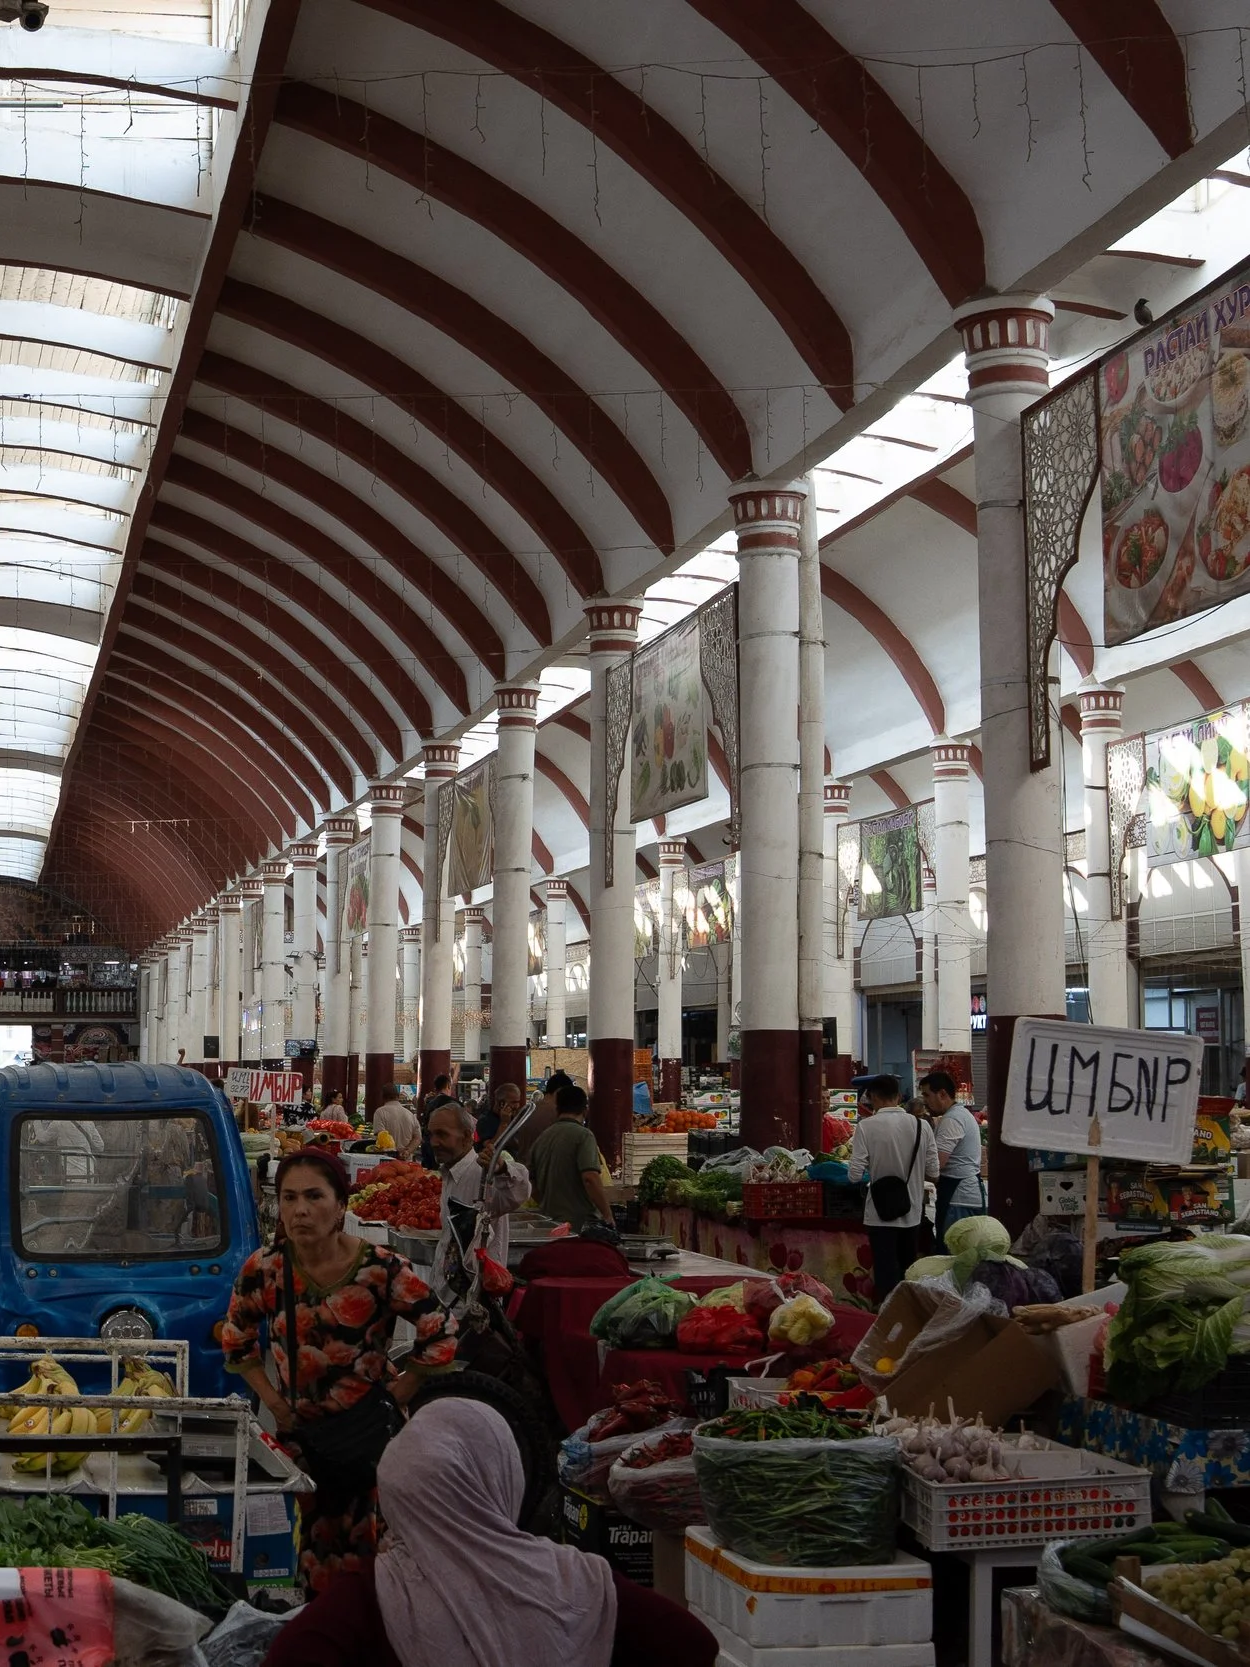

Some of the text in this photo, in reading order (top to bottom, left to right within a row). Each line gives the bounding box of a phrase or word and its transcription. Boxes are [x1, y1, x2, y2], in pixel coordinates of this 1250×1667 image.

[1143, 308, 1209, 377] РАСТАИ
[250, 1071, 302, 1103] ИМБИР
[1193, 1128, 1212, 1140] ANO
[1130, 1182, 1143, 1190] SAN
[1119, 1190, 1154, 1202] SEBASTIANO
[1181, 1208, 1219, 1218] SEBASTIANO
